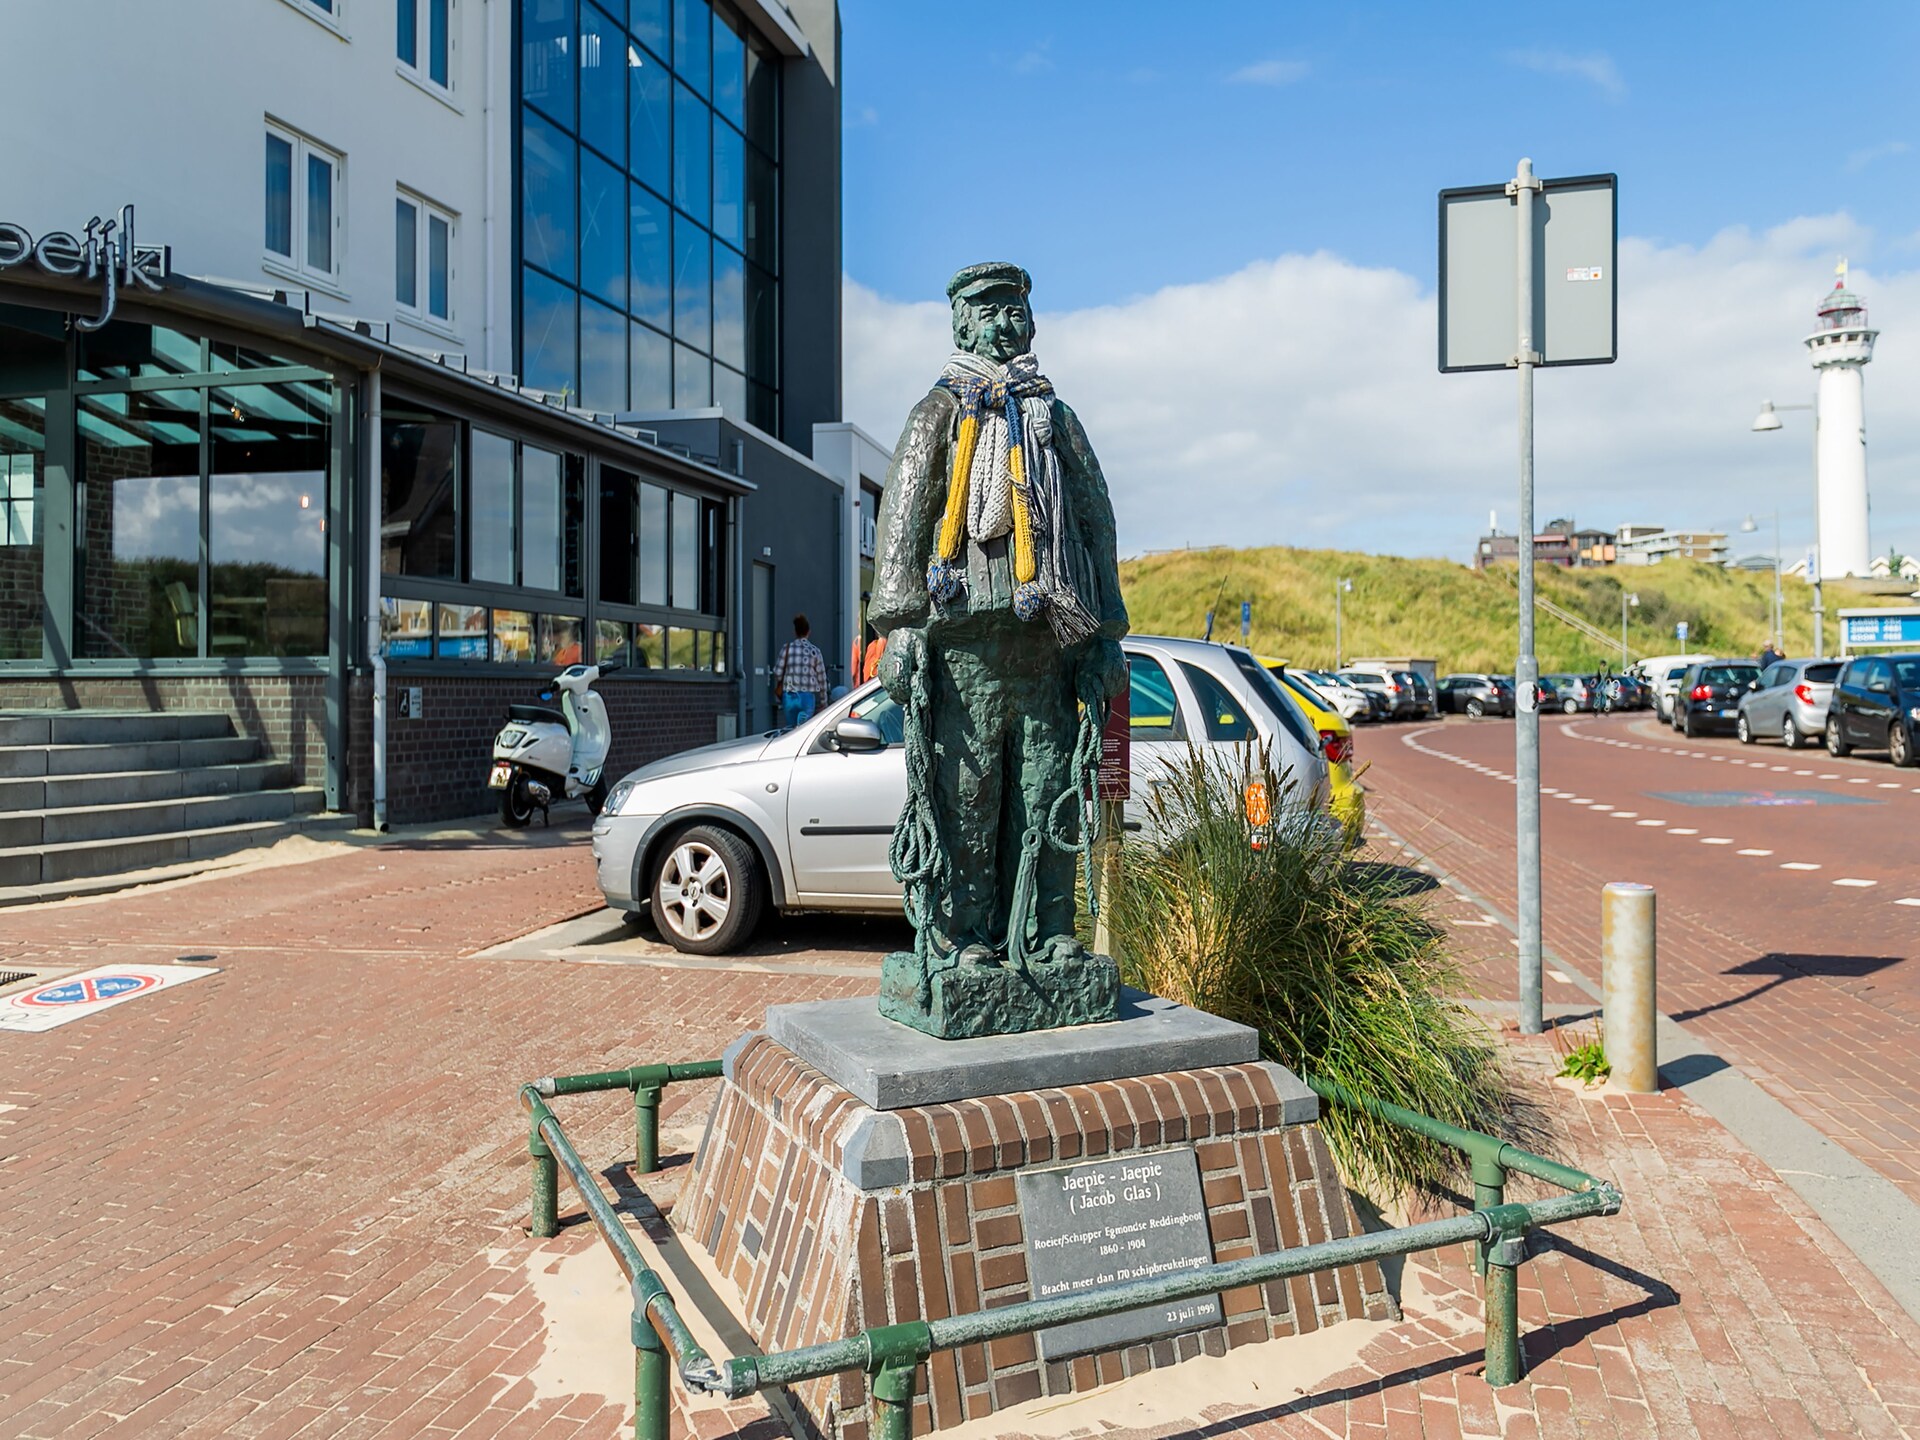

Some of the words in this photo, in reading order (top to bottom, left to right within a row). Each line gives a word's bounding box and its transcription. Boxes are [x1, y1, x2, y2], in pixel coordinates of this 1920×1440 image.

[1062, 1170, 1105, 1193] Jaepie
[1120, 1161, 1162, 1184] Jaepie
[1034, 1230, 1102, 1250] Roeier/Schipper
[1105, 1222, 1147, 1239] Egmondse
[1150, 1212, 1202, 1229] Reddingboot
[1100, 1243, 1119, 1256] 1860
[1127, 1238, 1146, 1251] 1904
[1041, 1280, 1070, 1296] Bracht
[1072, 1277, 1094, 1289] meer
[1097, 1272, 1114, 1284] dan
[1117, 1268, 1130, 1281] 170
[1132, 1255, 1208, 1277] schipbreukelingen
[1166, 1311, 1177, 1322] 23
[1179, 1306, 1195, 1323] juli
[1197, 1303, 1215, 1316] 1999
